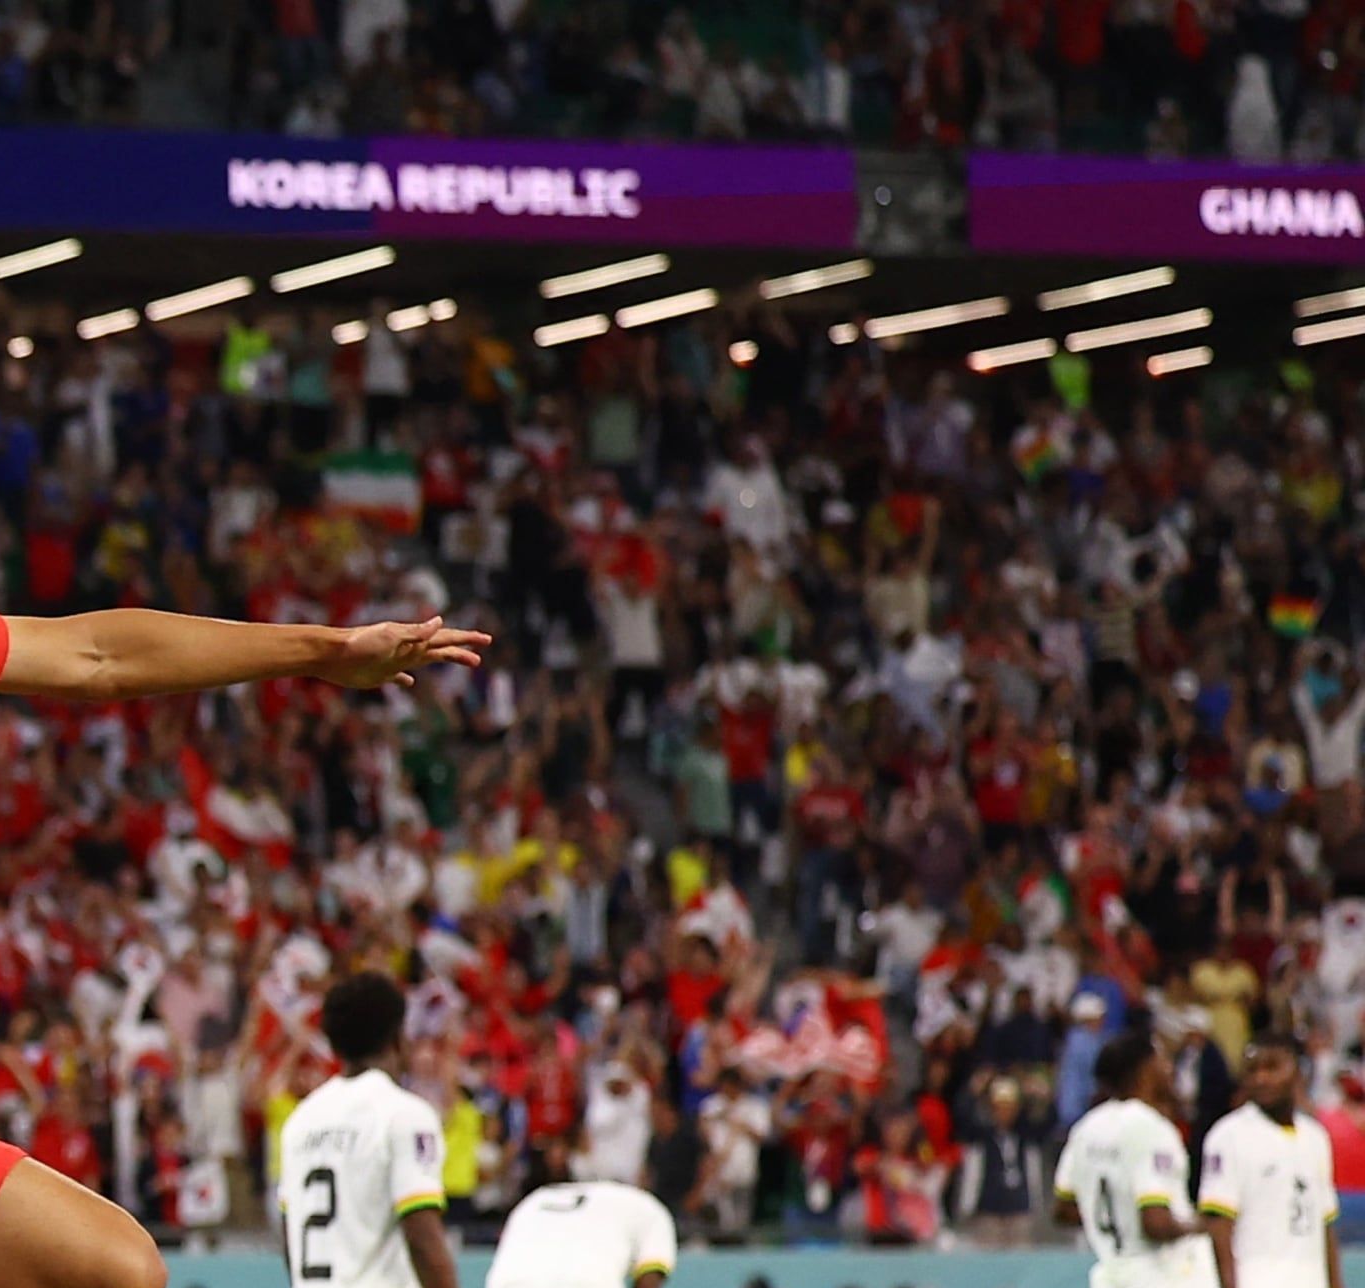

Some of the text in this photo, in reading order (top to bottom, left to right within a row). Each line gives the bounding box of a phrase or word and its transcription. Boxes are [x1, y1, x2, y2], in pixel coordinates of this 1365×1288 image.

[228, 158, 642, 219] KOREA REPUBLIC
[1199, 185, 1365, 239] GHANA
[301, 1167, 337, 1280] 2
